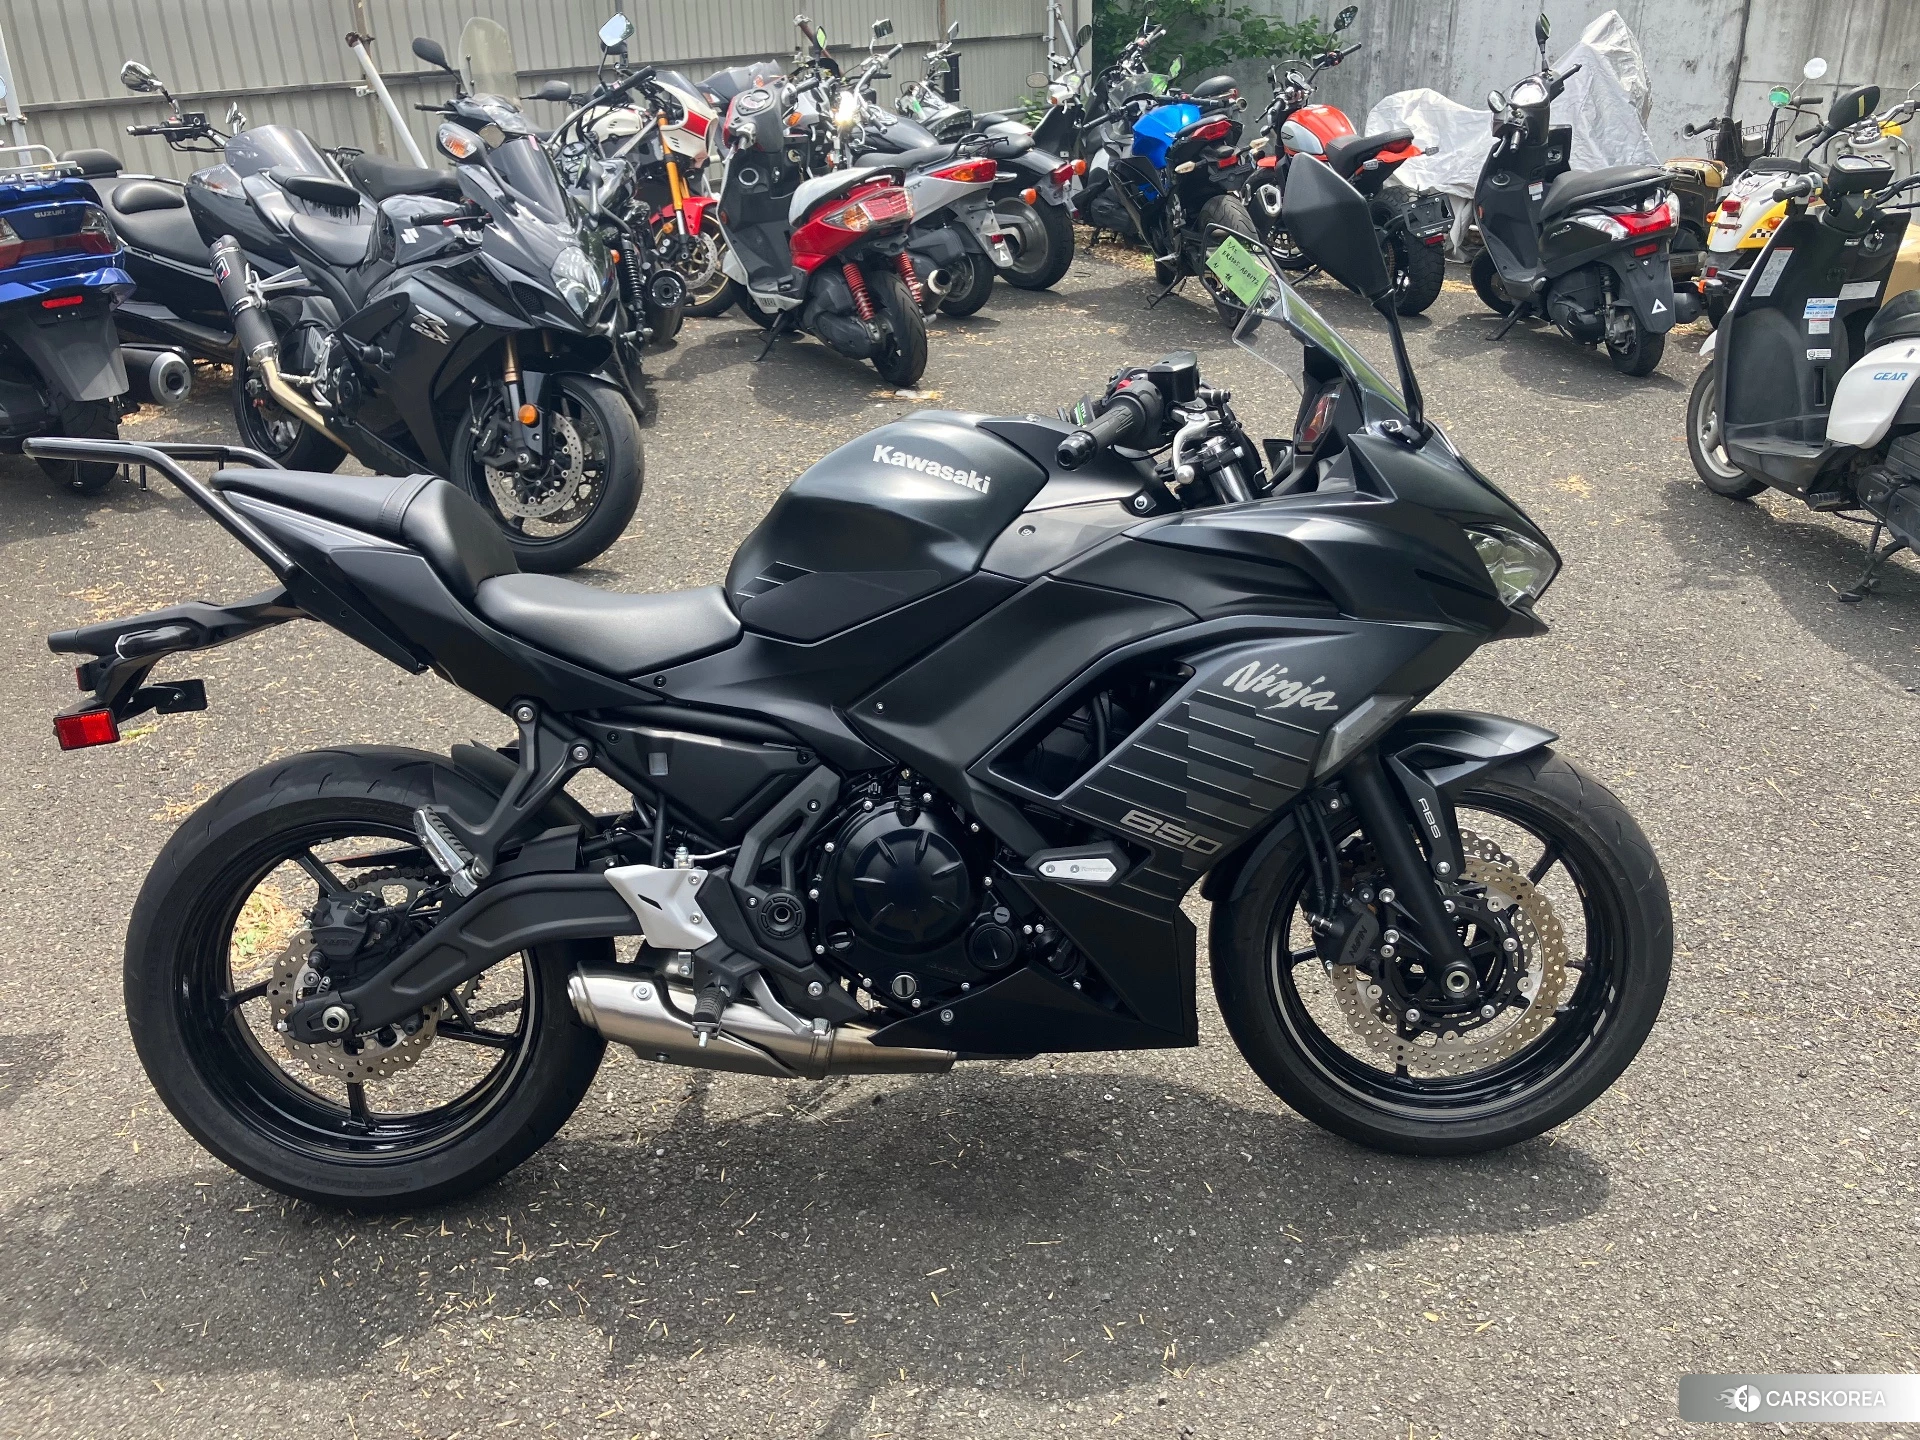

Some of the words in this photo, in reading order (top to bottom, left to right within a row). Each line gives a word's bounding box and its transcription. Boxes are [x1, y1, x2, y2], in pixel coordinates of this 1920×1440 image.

[34, 209, 66, 218] SUZUKI
[410, 322, 451, 345] GSX
[1873, 372, 1909, 381] GEAR
[873, 444, 992, 494] Kawasaki
[1222, 660, 1339, 711] Ninja
[1120, 809, 1223, 855] 650
[1417, 797, 1441, 839] ABS
